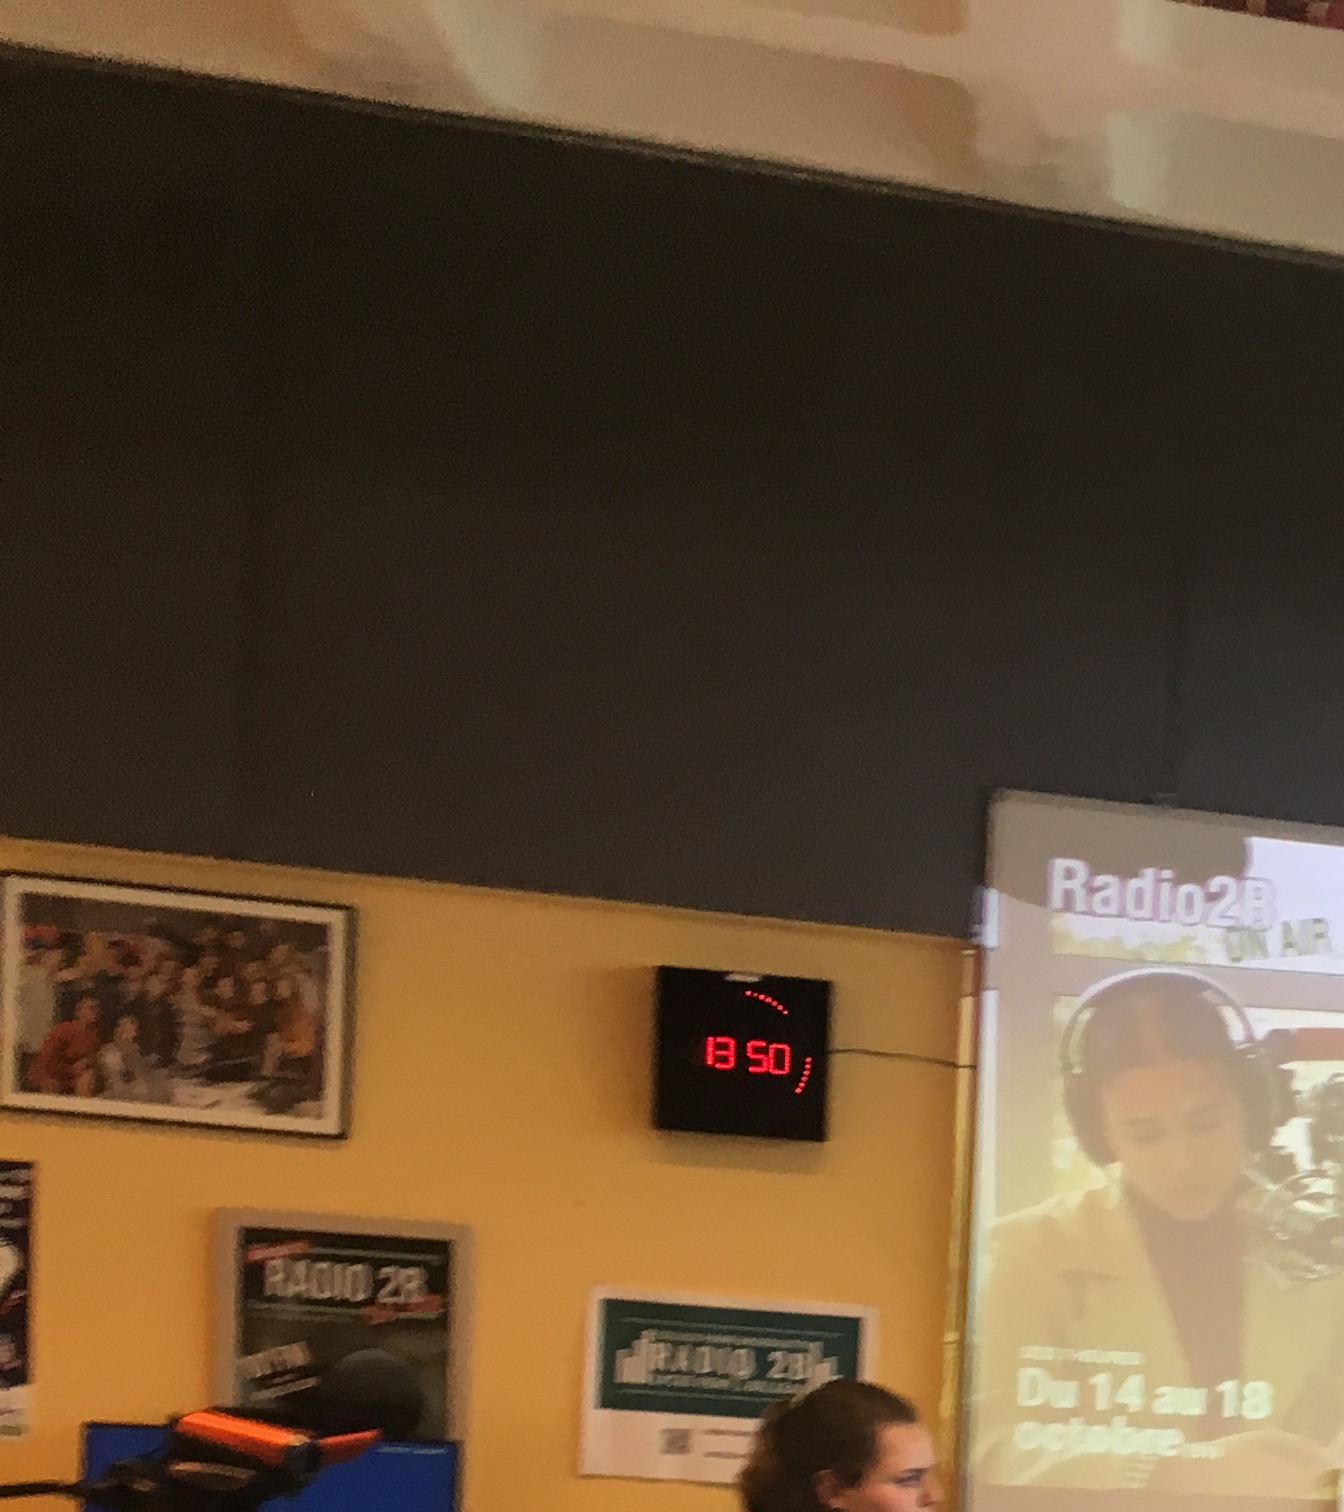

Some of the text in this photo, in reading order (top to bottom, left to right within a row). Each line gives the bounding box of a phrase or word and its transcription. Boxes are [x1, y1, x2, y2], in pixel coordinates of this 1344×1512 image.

[1047, 857, 1277, 932] Radio2B
[704, 1035, 791, 1075] 13 50
[1016, 1366, 1081, 1409] Du
[1088, 1371, 1147, 1413] 14
[1214, 1379, 1275, 1420] 18
